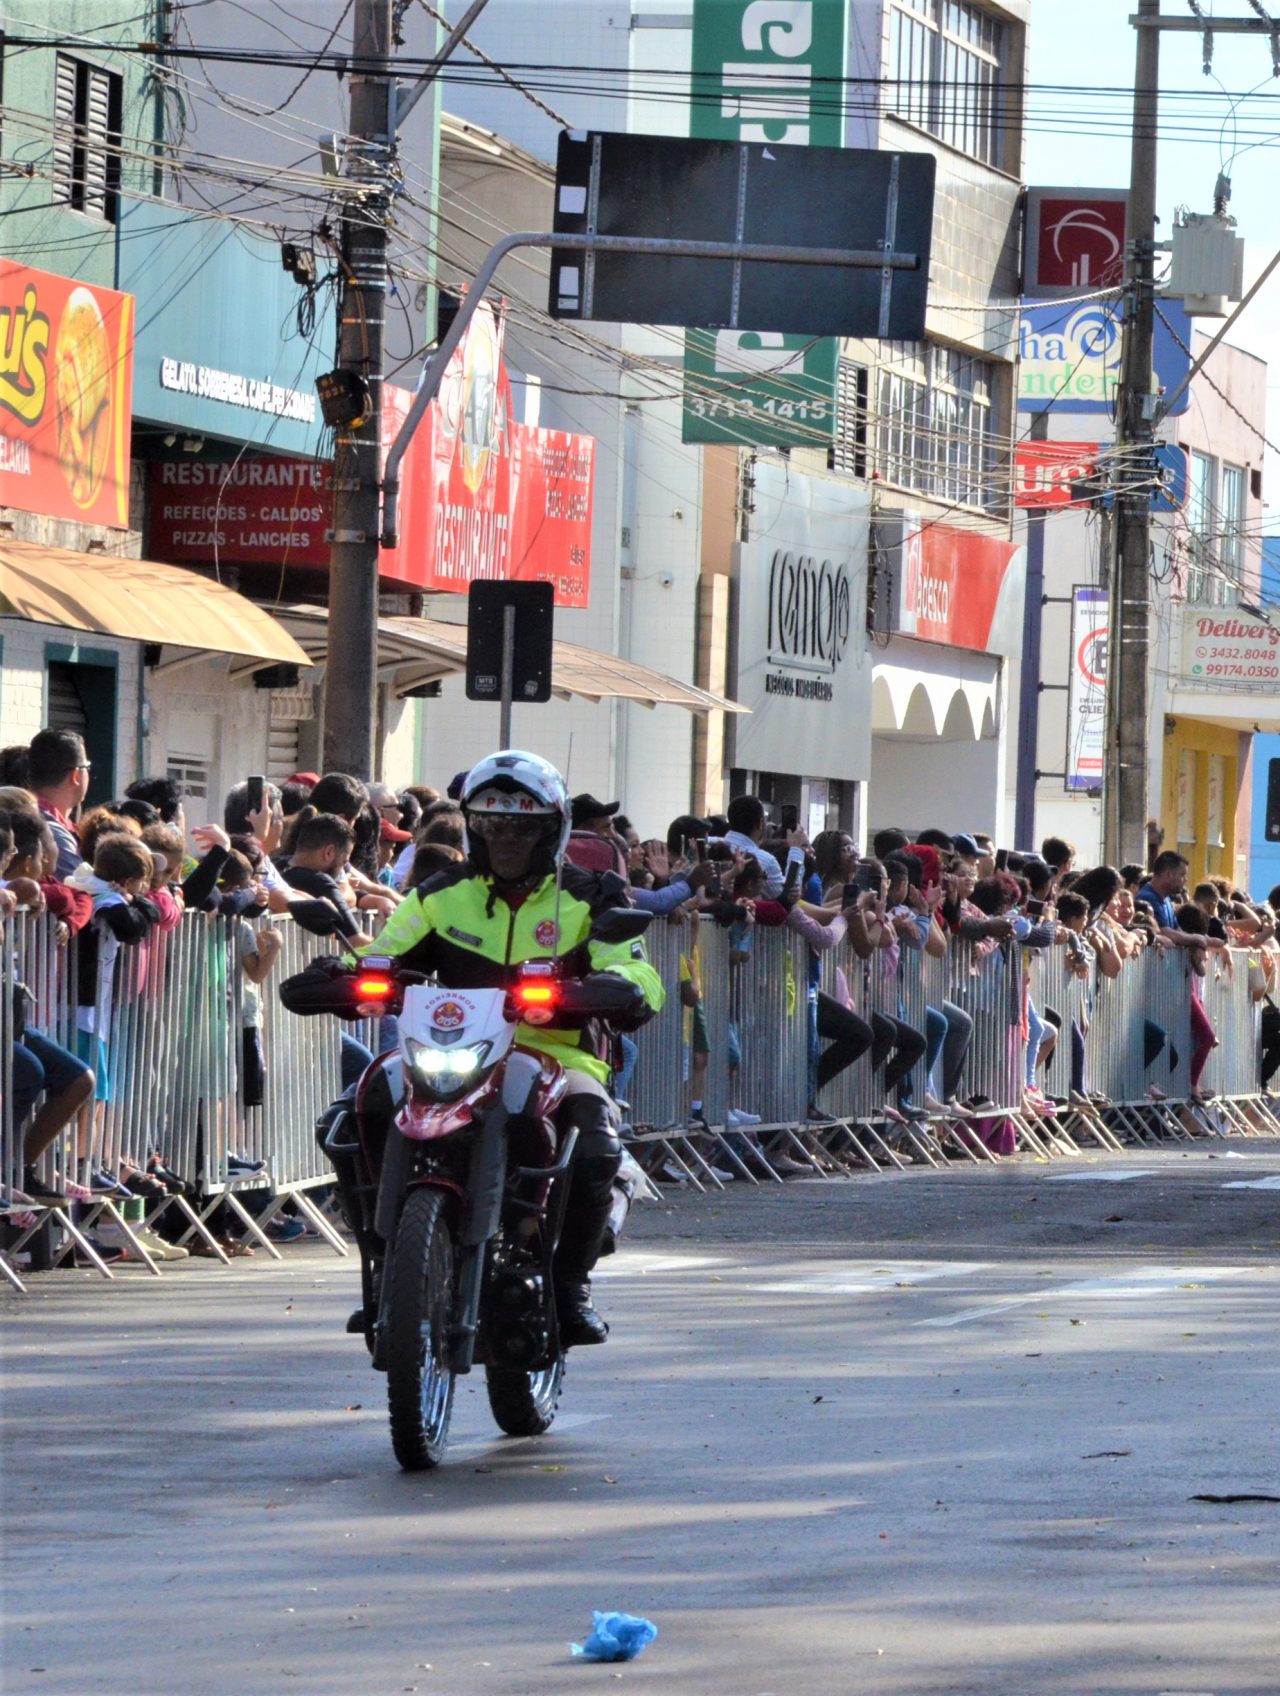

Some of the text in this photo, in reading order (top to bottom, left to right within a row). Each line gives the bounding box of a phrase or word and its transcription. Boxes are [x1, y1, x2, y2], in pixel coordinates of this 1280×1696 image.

[162, 463, 323, 487] RESTAURANTE
[163, 503, 247, 522] REFEIÇÕES
[259, 507, 321, 521] CALDOS
[172, 531, 226, 545] PIZZAS
[239, 533, 310, 547] LANCHES
[434, 502, 509, 580] RESTAURANTE
[1196, 617, 1280, 645] Delivery
[1209, 647, 1277, 661] 3432.8048
[1206, 663, 1280, 678] 99174.0350
